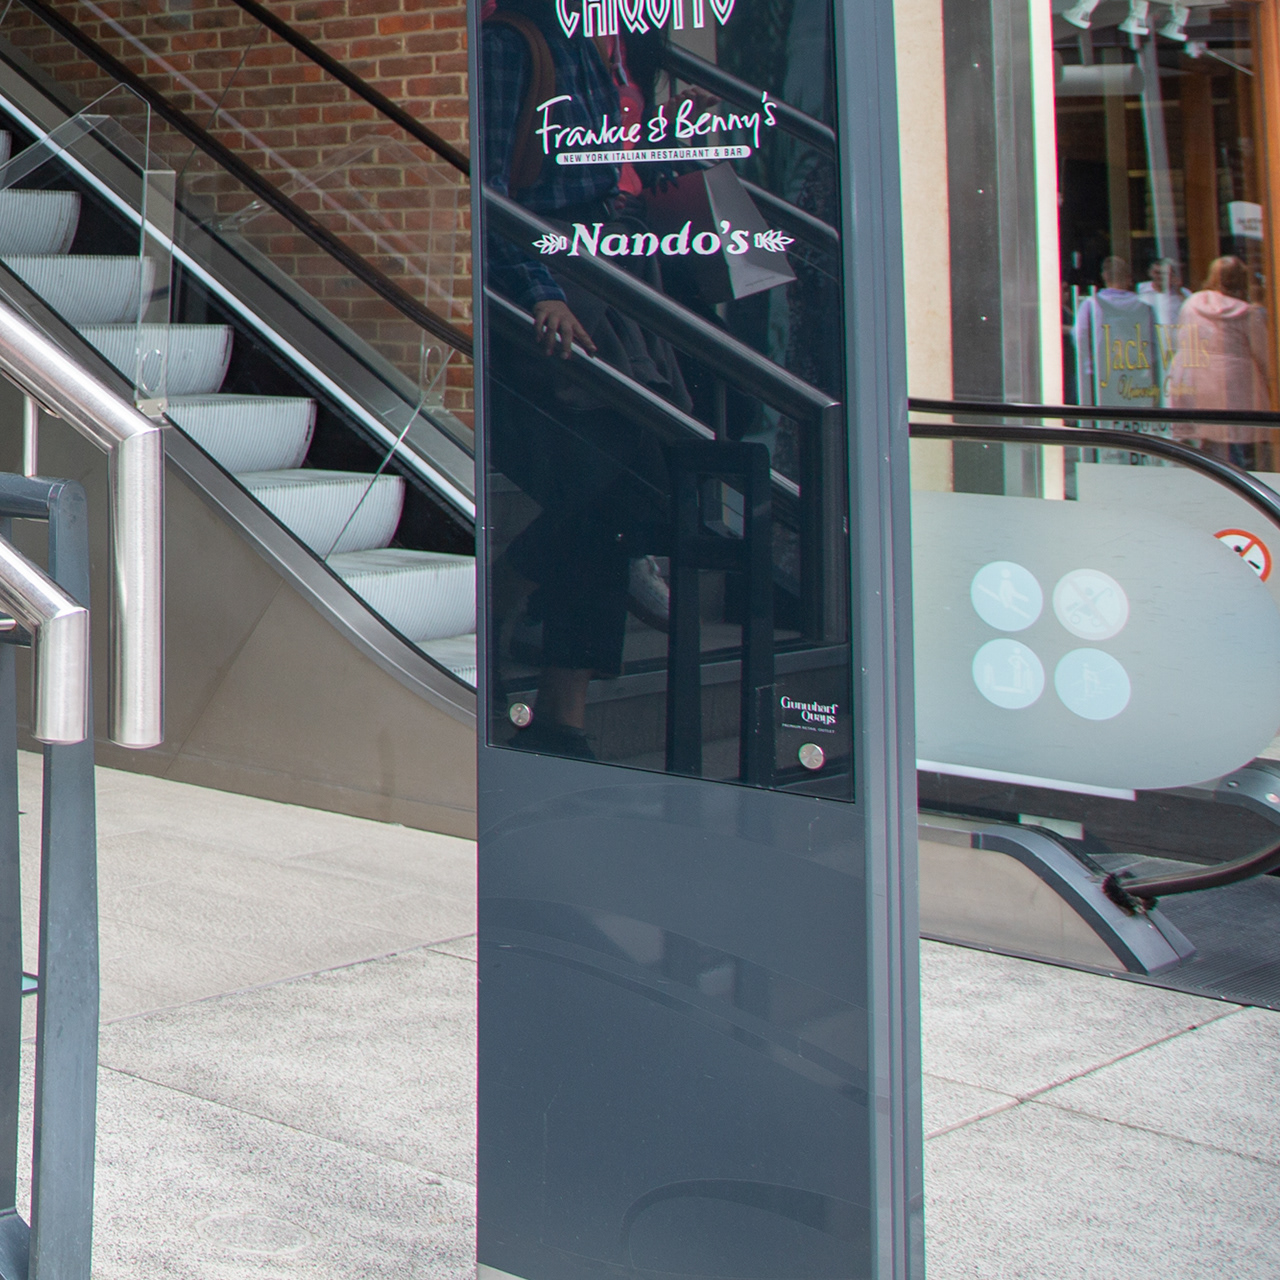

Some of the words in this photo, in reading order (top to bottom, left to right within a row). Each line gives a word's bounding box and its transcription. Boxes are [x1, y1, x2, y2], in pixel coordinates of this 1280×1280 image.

[535, 94, 642, 155] Frankie
[647, 105, 668, 142] &
[675, 91, 777, 149] Benny's
[563, 153, 582, 163] NEW
[585, 152, 609, 162] YORK
[612, 150, 647, 161] ITALIAN
[650, 148, 710, 160] RESTAURANT
[713, 148, 720, 158] &
[723, 147, 743, 157] BAR
[566, 220, 750, 258] Nando's
[1100, 322, 1151, 388] Jack
[1154, 323, 1210, 370] Wills
[780, 696, 838, 714] Gunwharf
[801, 710, 836, 725] Quays
